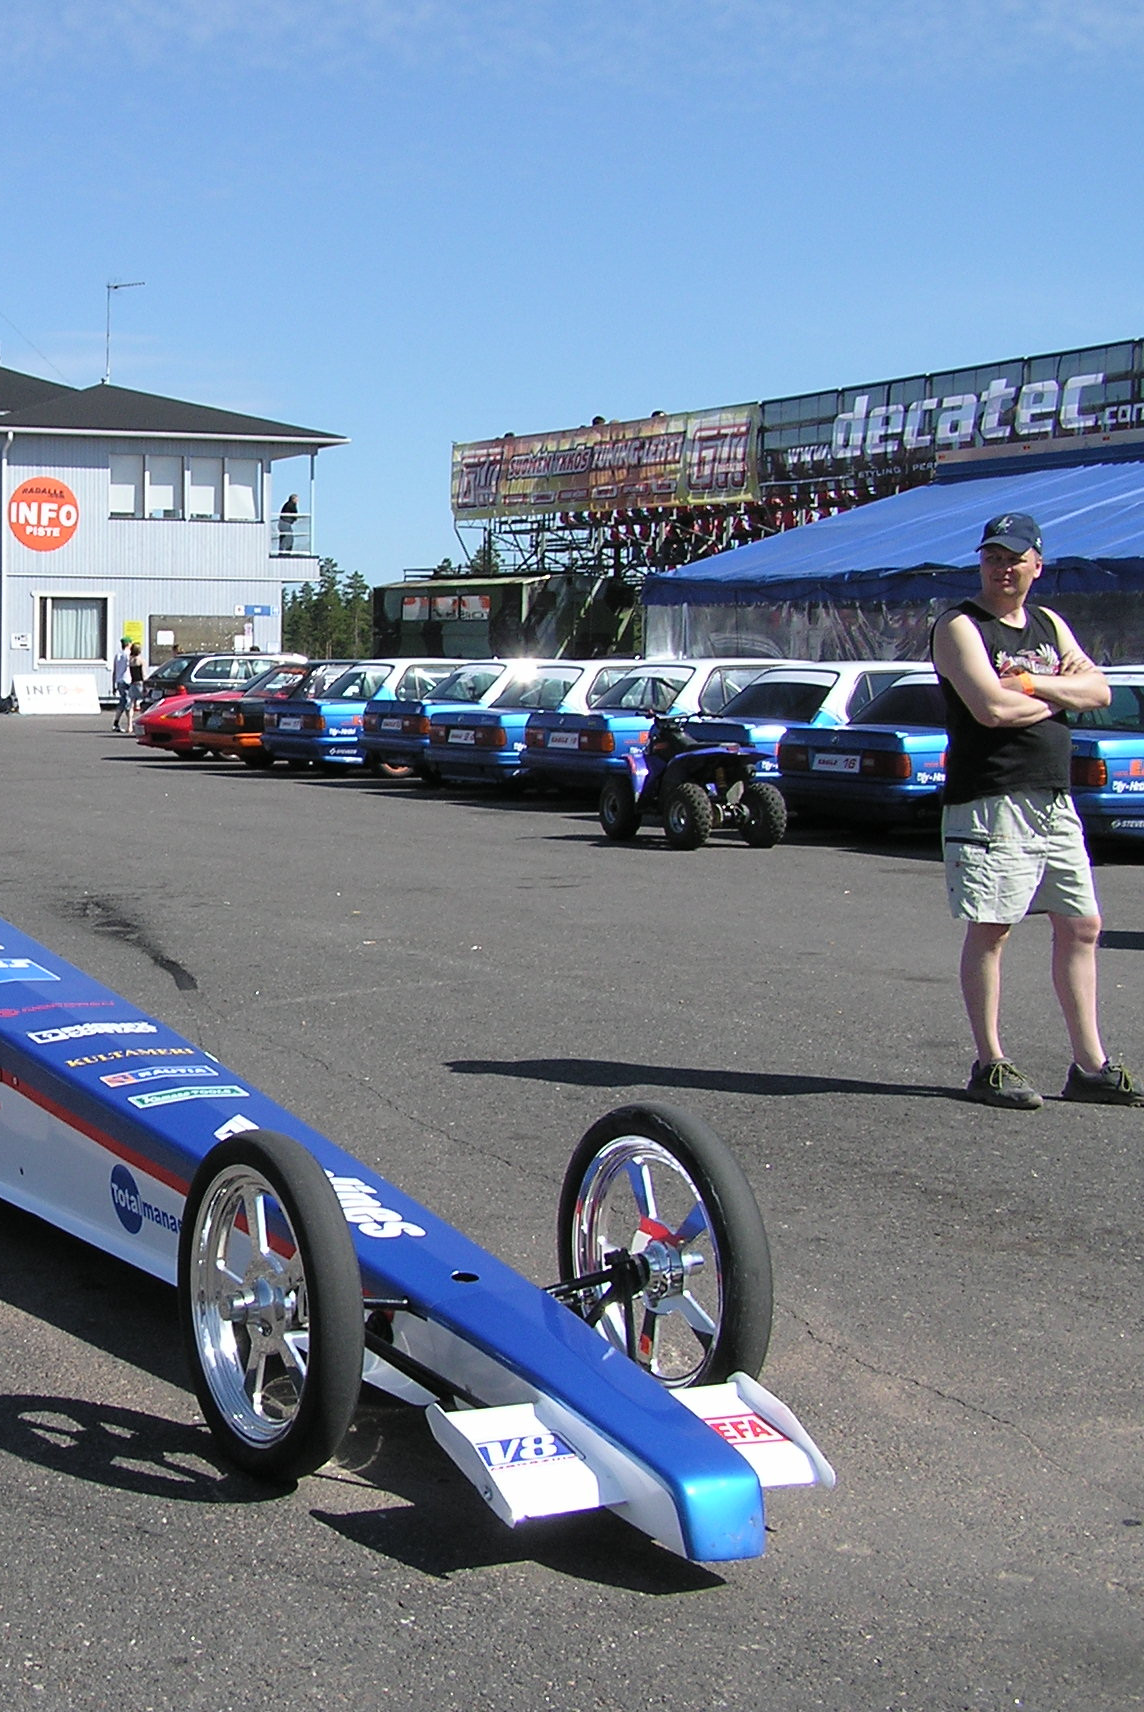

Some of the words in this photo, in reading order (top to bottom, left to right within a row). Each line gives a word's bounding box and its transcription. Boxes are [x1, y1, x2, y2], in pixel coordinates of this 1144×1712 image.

[858, 466, 901, 478] STYLING
[10, 502, 77, 525] INFO
[26, 526, 60, 537] PISTE
[65, 1048, 194, 1067] KULTAMERI
[323, 1168, 426, 1238] lines
[709, 1420, 773, 1439] EFA
[483, 1434, 557, 1465] V8
